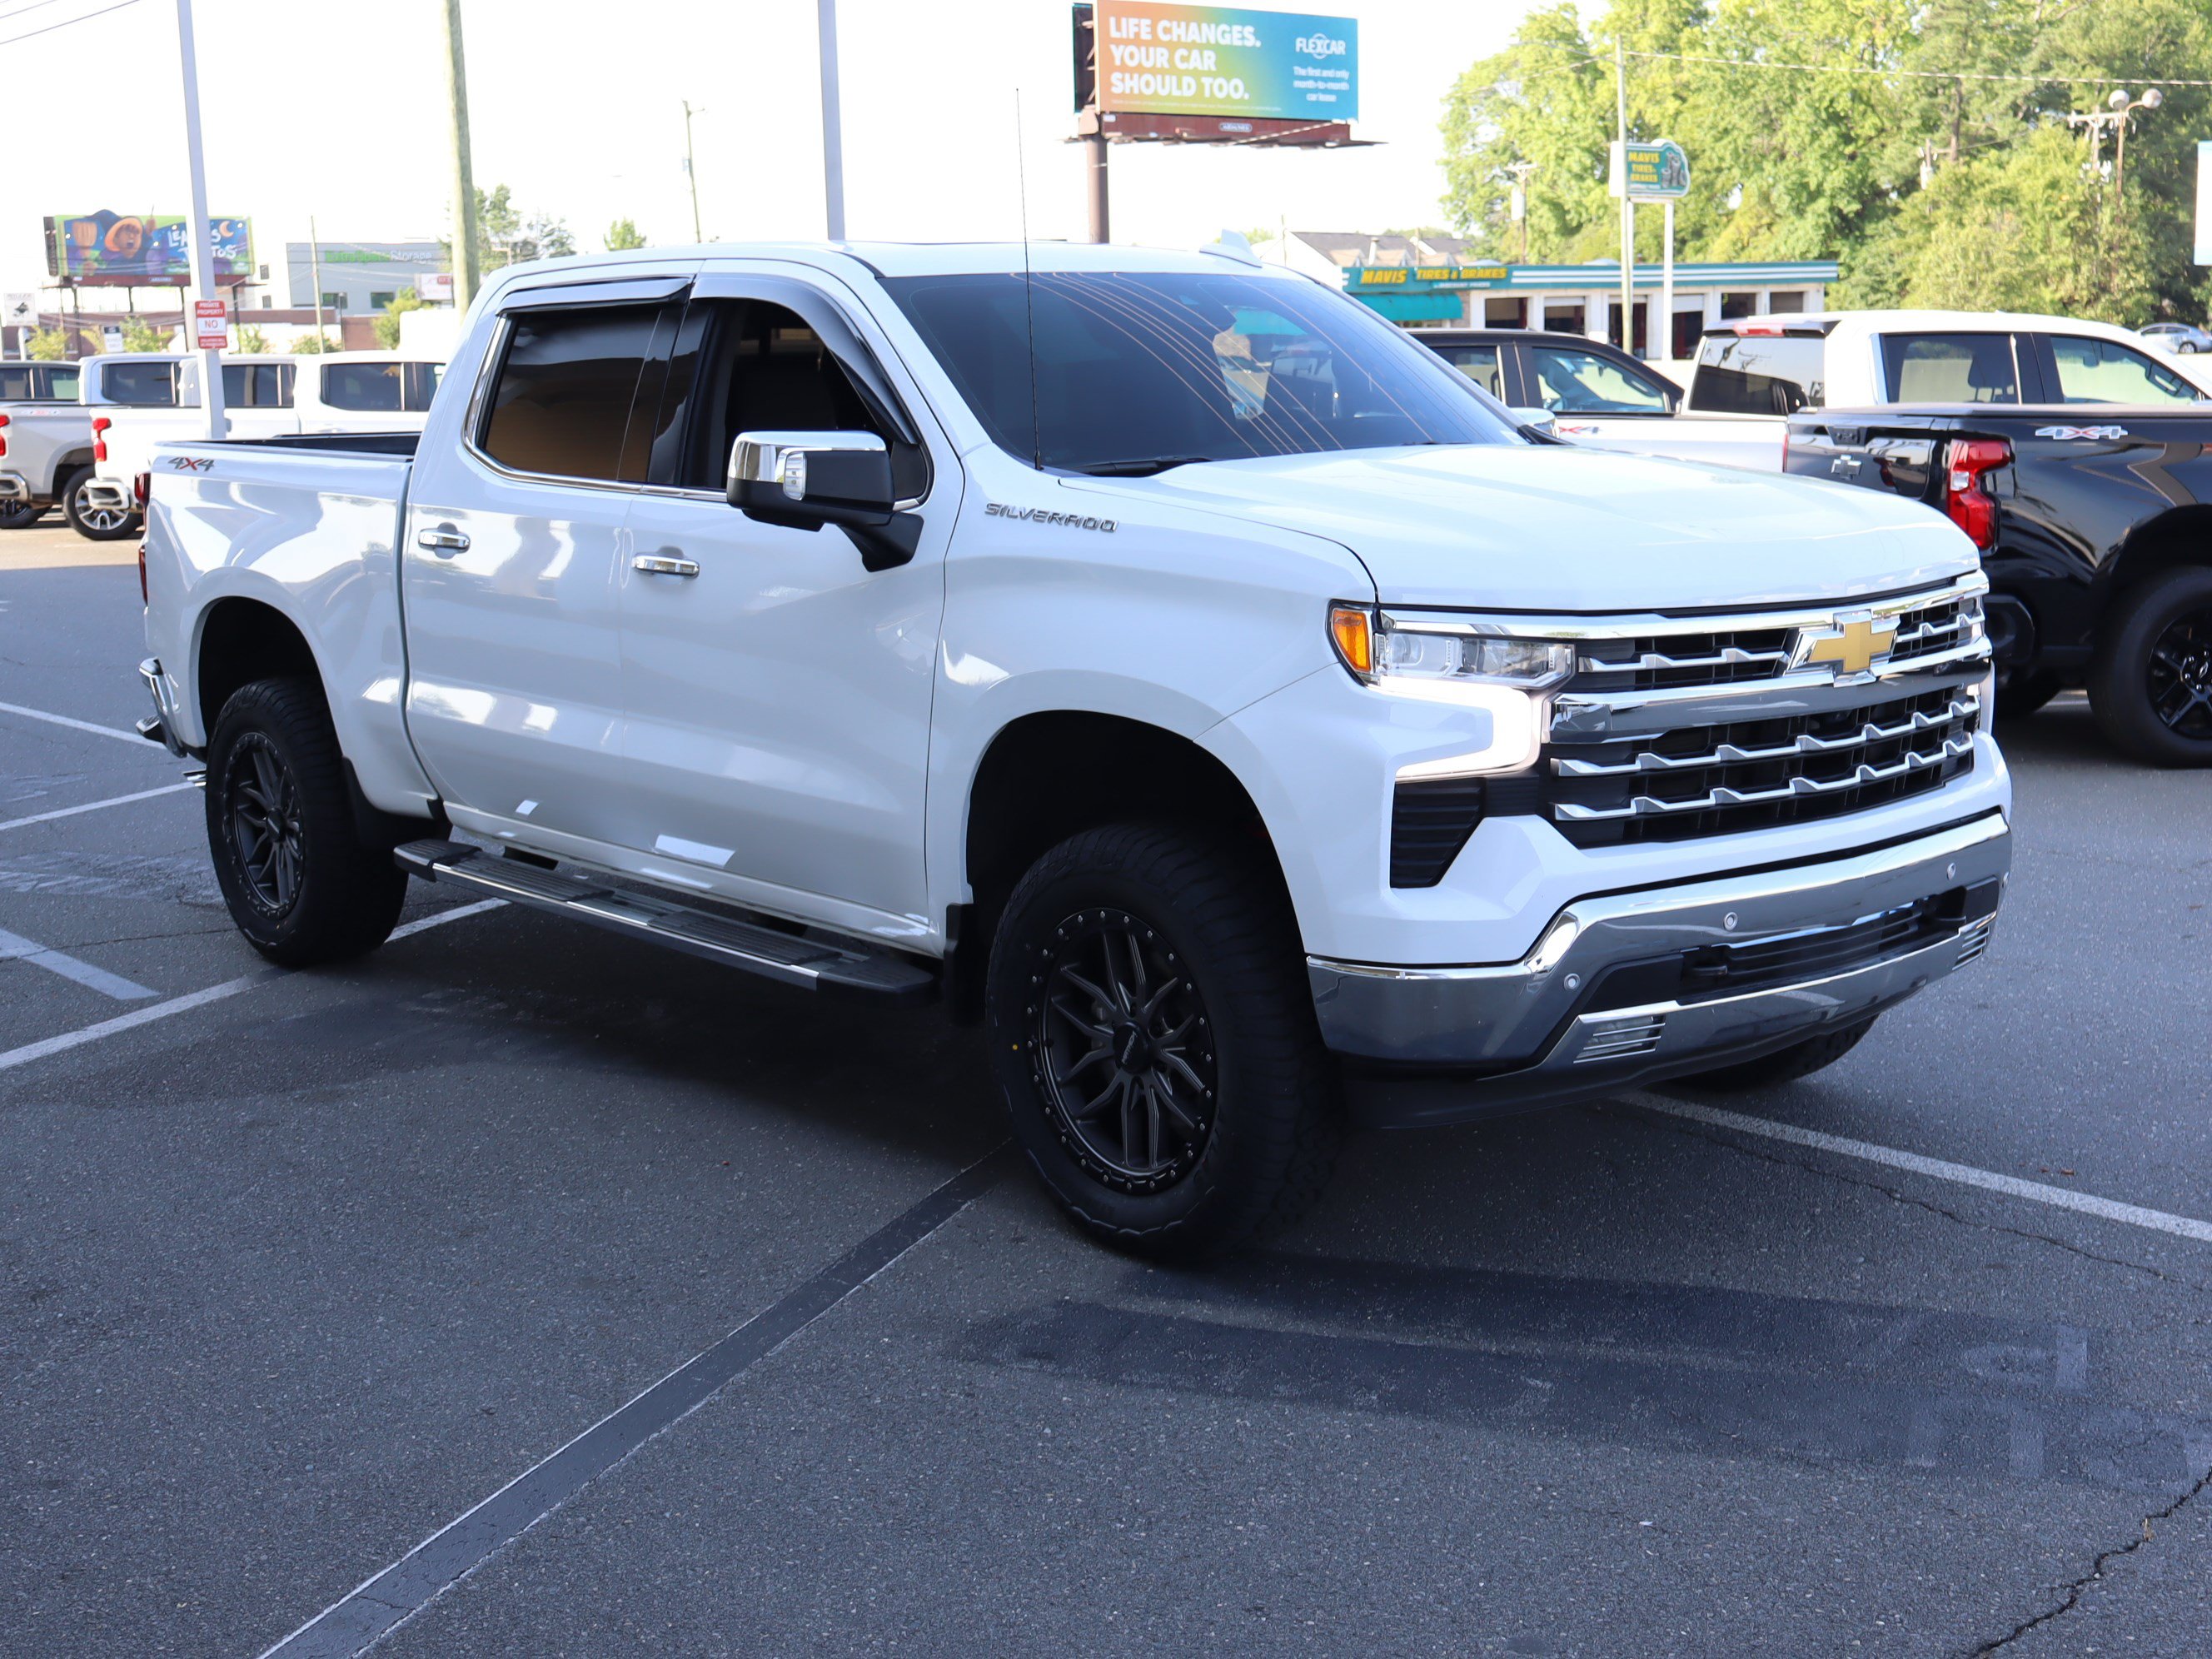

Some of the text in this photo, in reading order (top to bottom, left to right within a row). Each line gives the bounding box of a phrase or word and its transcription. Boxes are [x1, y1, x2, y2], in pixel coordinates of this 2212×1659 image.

[1109, 17, 1261, 47] LIFE CHANGES.
[1295, 37, 1347, 56] FLEXCAR
[1109, 45, 1217, 72] YOUR CAR
[1293, 66, 1306, 76] The
[1110, 72, 1250, 101] SHOULD TOO.
[1628, 152, 1660, 162] MAVIS
[1361, 269, 1407, 284] MAVIS
[1417, 269, 1451, 281] TIRES
[1460, 267, 1507, 279] BRAKES
[205, 320, 218, 329] NO
[984, 502, 1119, 533] SILVERADO
